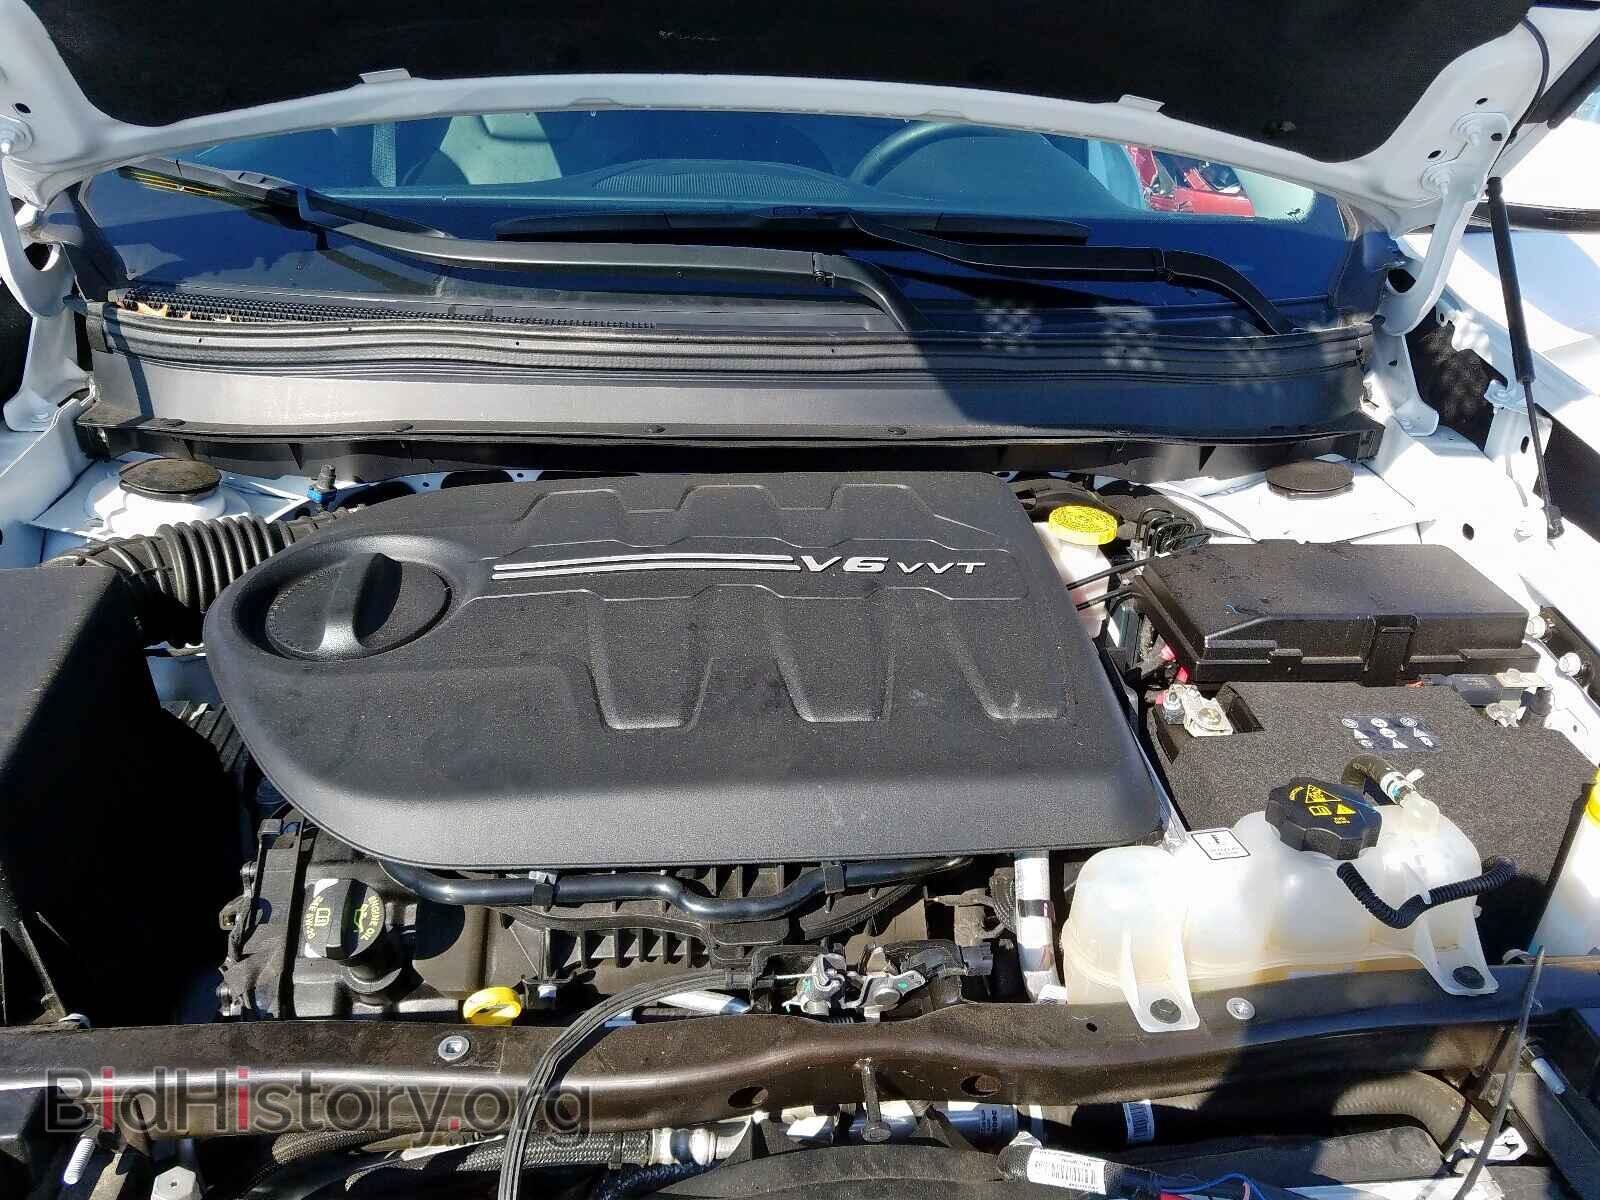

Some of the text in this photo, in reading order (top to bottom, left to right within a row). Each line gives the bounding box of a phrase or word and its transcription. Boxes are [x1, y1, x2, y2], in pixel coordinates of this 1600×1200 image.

[800, 555, 987, 575] V6 VVT
[359, 895, 381, 941] ENGINE OIL
